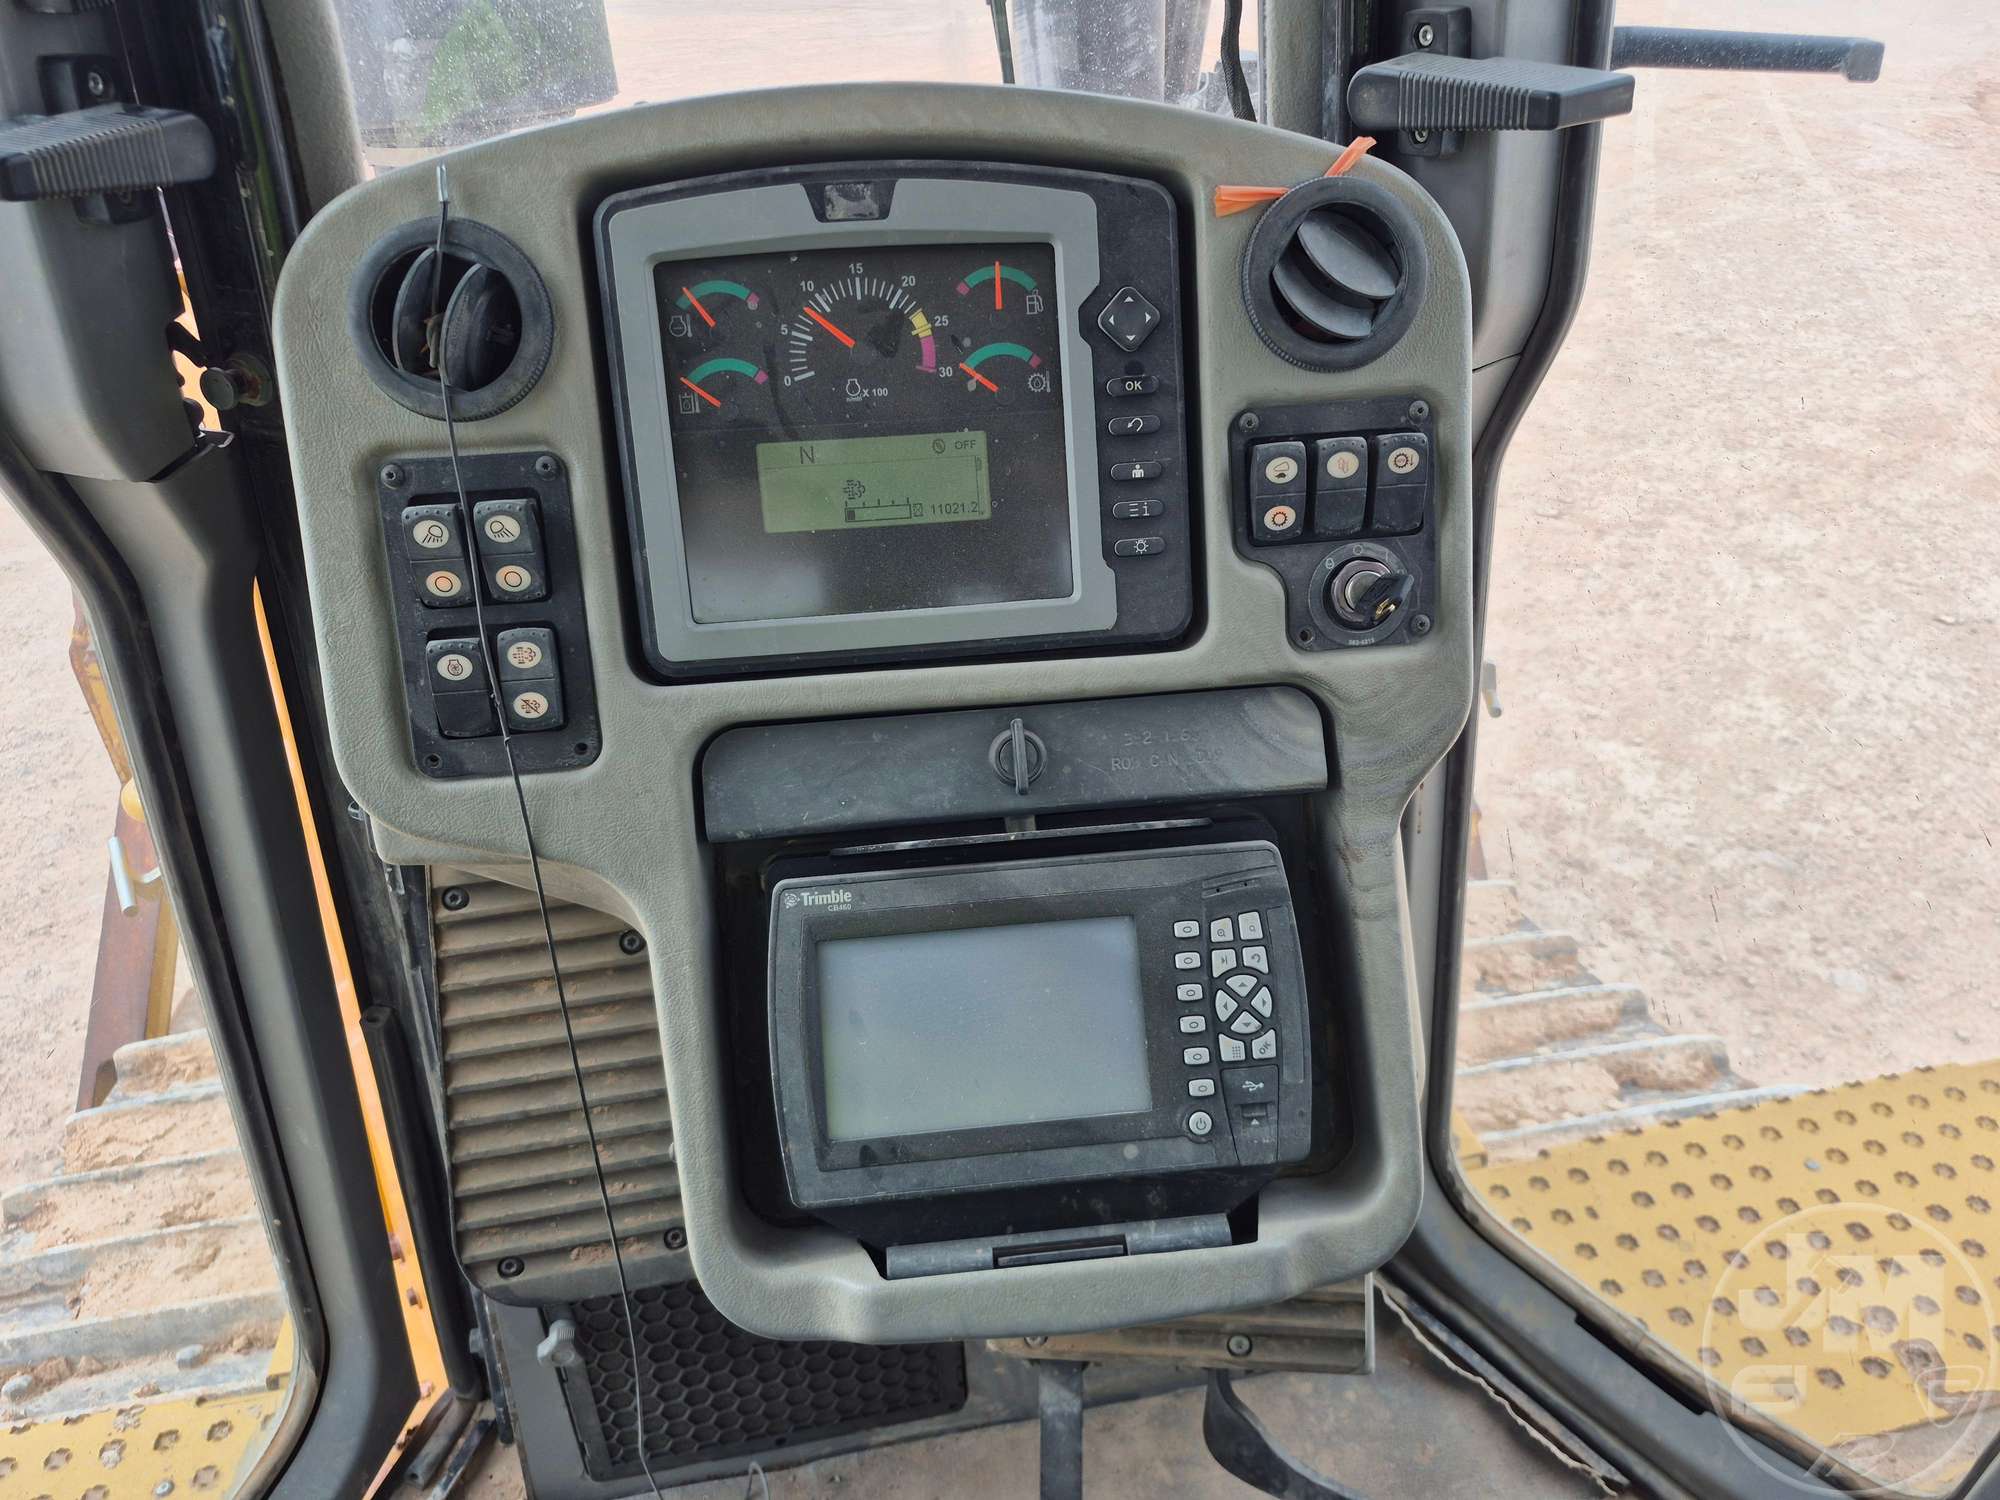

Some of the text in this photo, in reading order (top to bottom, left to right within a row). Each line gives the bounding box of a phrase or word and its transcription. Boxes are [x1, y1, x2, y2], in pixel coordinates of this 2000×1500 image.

[849, 263, 864, 274] 15
[800, 280, 815, 292] 10
[901, 275, 916, 287] 20
[934, 315, 949, 327] 25
[780, 325, 788, 336] 5
[938, 366, 953, 378] 30
[784, 375, 792, 386] 0
[1125, 380, 1142, 391] OK
[872, 388, 888, 397] 100
[954, 440, 977, 450] OFF
[800, 446, 815, 464] N
[930, 501, 979, 515] 11021.2
[801, 889, 852, 906] Trimble
[1259, 1041, 1271, 1054] OK
